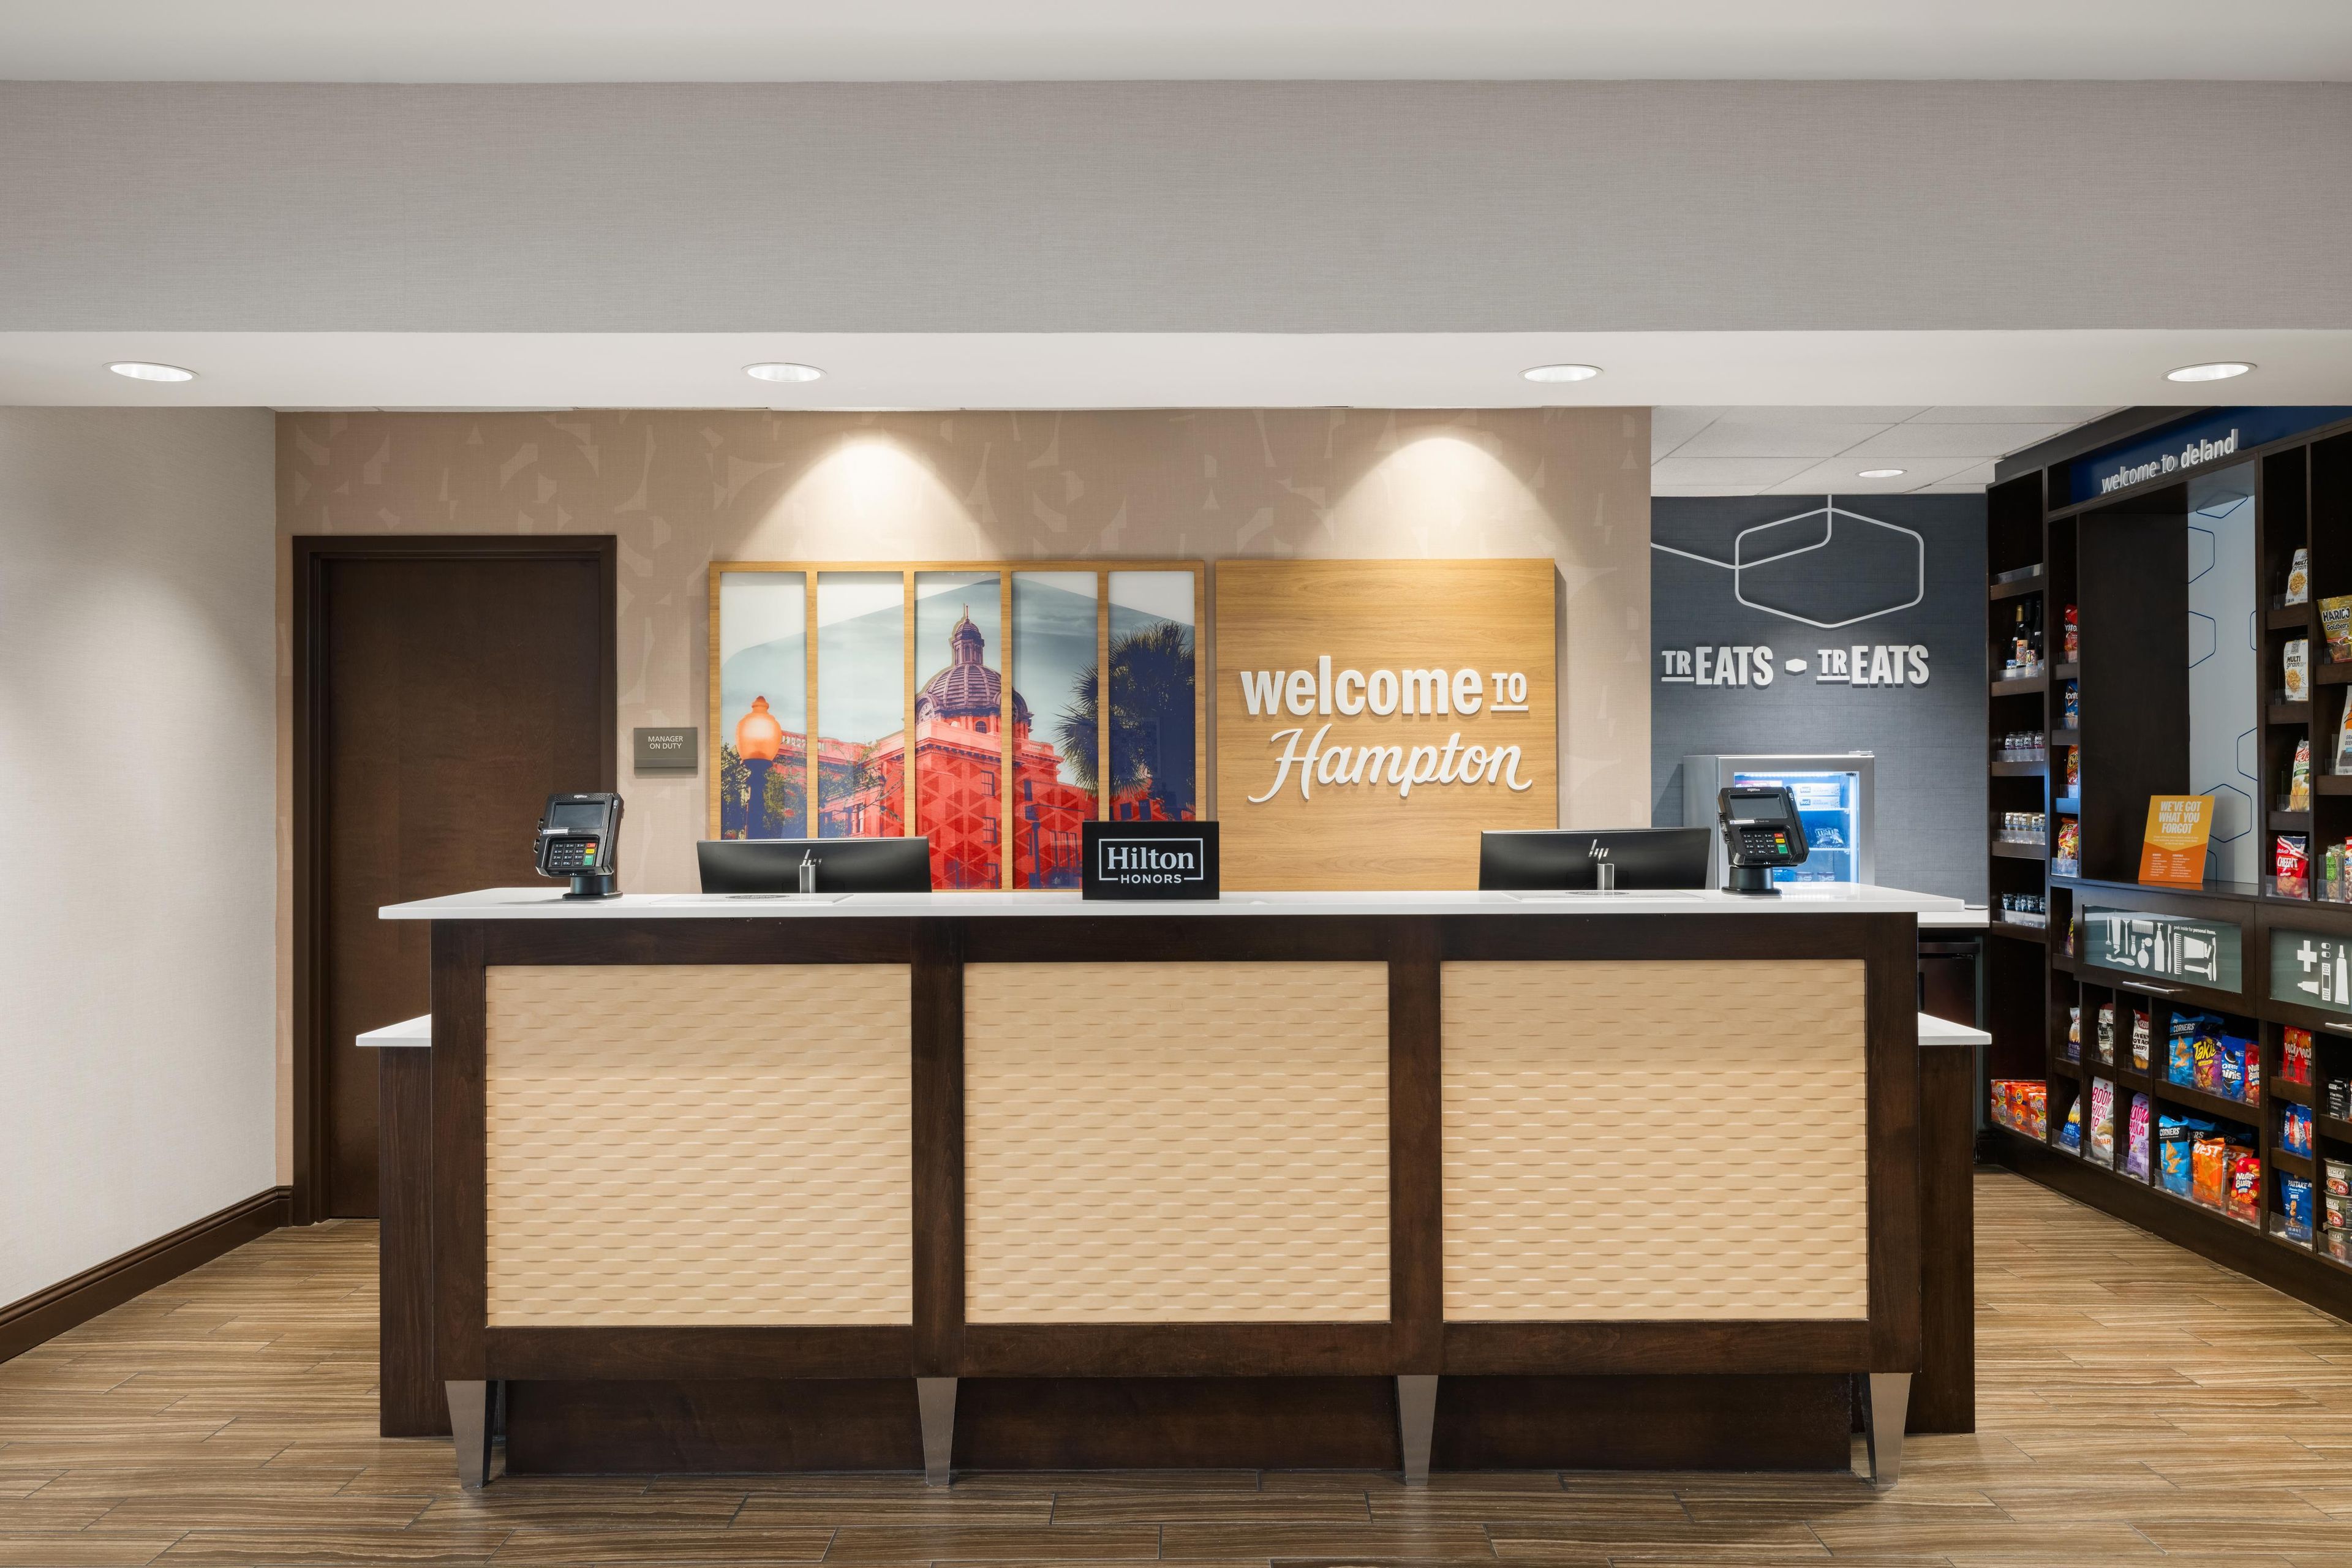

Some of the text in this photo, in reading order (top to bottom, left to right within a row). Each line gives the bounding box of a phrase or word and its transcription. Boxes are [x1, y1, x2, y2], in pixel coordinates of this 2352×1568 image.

[2101, 429, 2238, 493] welcome to deland
[1661, 645, 1929, 685] TREATS TREATS
[1240, 655, 1528, 715] welcome TO
[1248, 723, 1532, 804] Hampton
[2160, 801, 2202, 812] WE'VE GOT
[2158, 812, 2200, 823] WHAT YOU
[2162, 823, 2193, 834] FORGOT
[1107, 847, 1194, 869] Hilton
[1121, 874, 1182, 884] HONORS
[2288, 1180, 2308, 1189] PARTAKE
